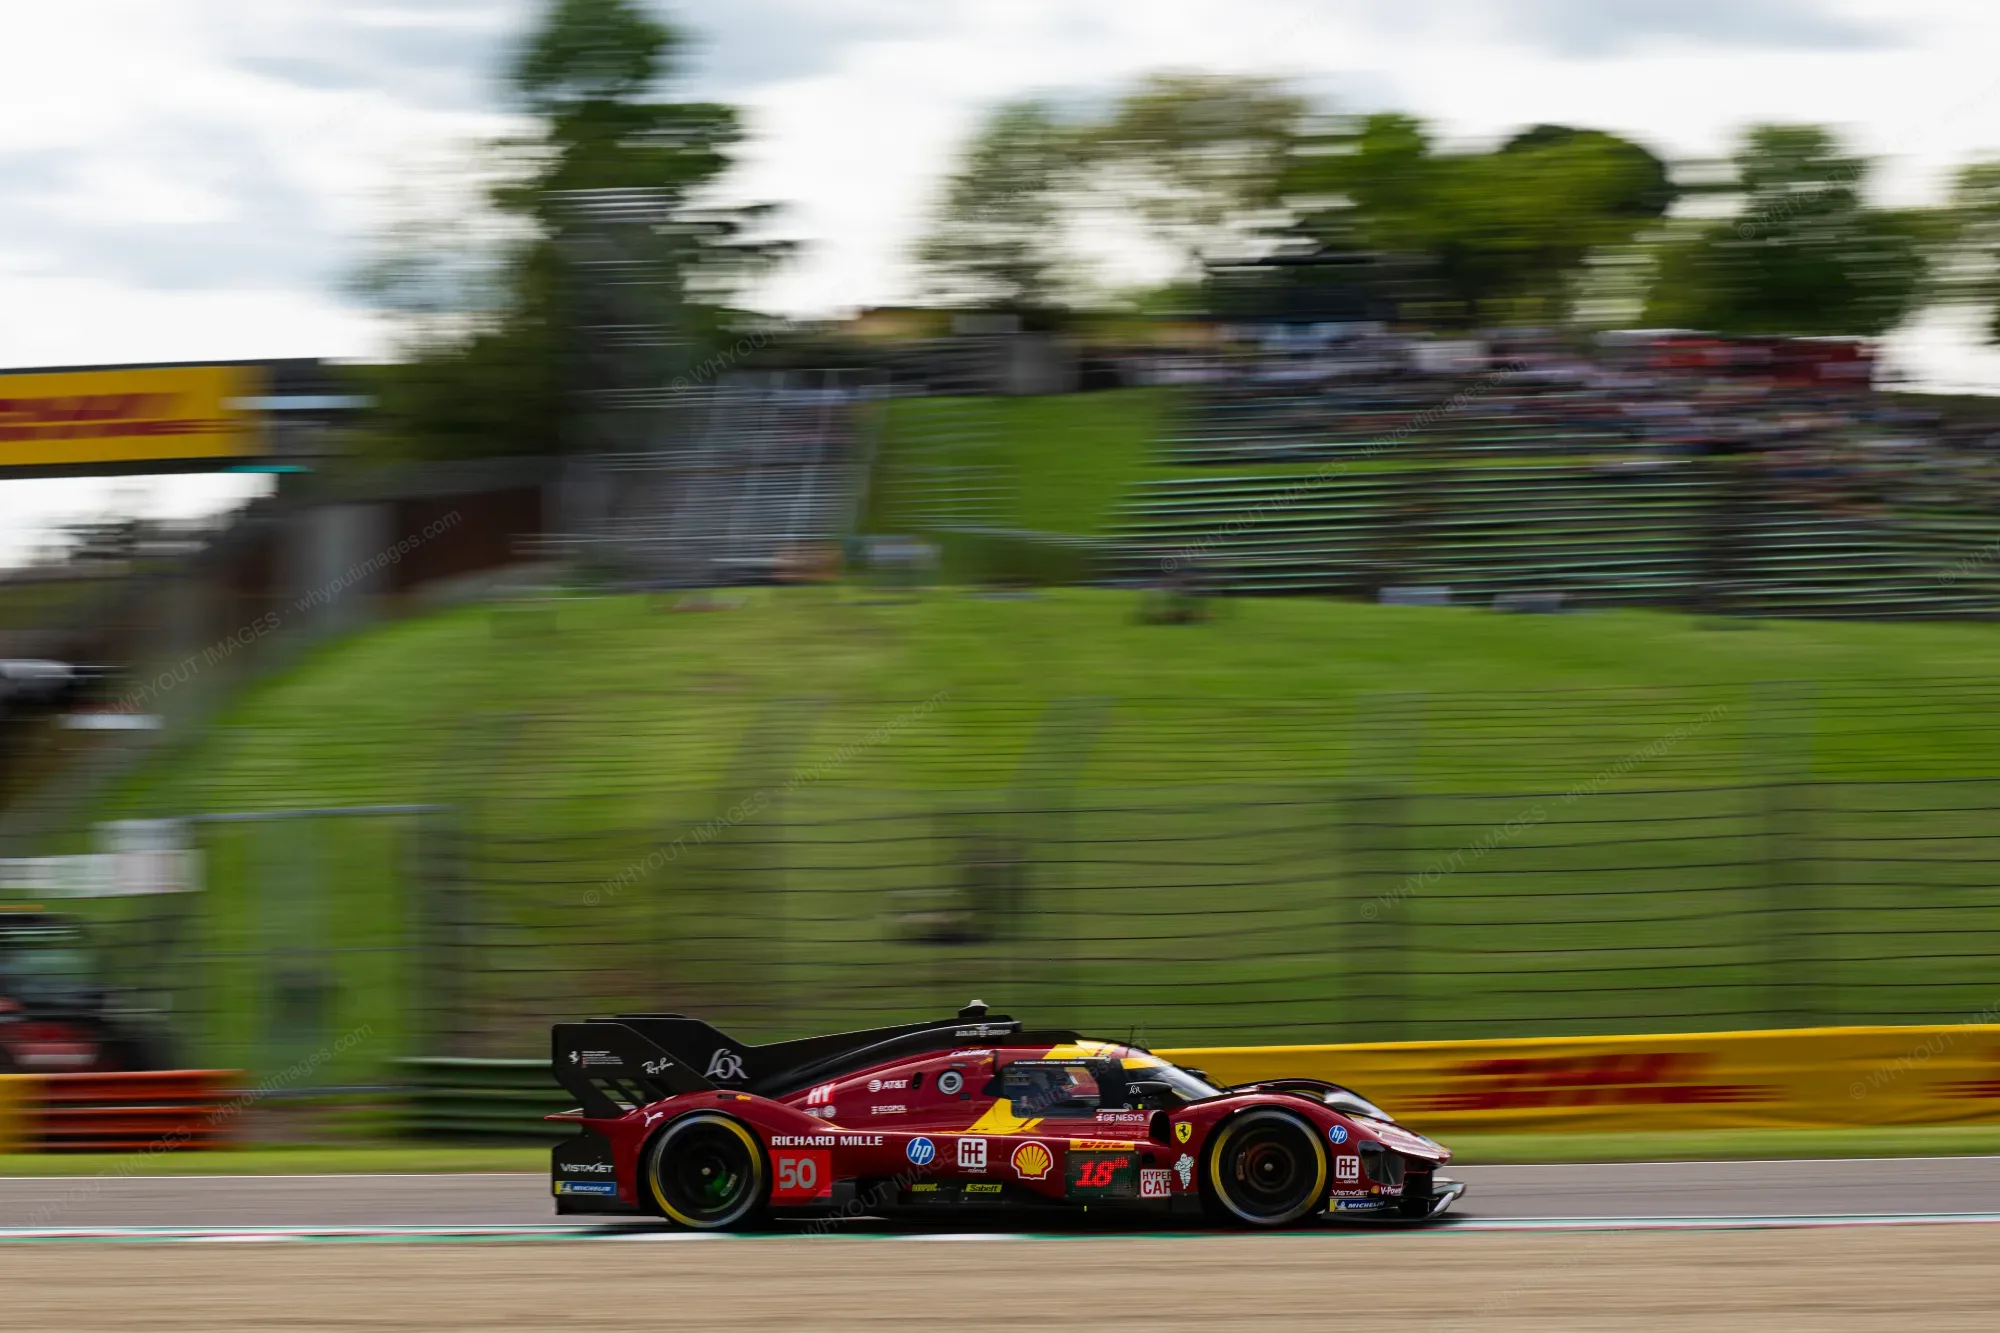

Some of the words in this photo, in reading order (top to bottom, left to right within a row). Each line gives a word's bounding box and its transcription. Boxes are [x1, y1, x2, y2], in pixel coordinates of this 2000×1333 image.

[882, 1079, 909, 1089] AT&T
[1103, 1113, 1144, 1122] GENESYS
[771, 1135, 836, 1146] RICHARD
[840, 1135, 883, 1146] MILLE
[1079, 1140, 1126, 1149] DHL
[779, 1158, 817, 1189] 50
[1142, 1171, 1172, 1180] HYPER
[969, 1184, 998, 1192] Sabelt
[1142, 1180, 1172, 1195] CAR
[1380, 1186, 1403, 1195] V-Powe
[1348, 1201, 1385, 1209] MICHELIN
